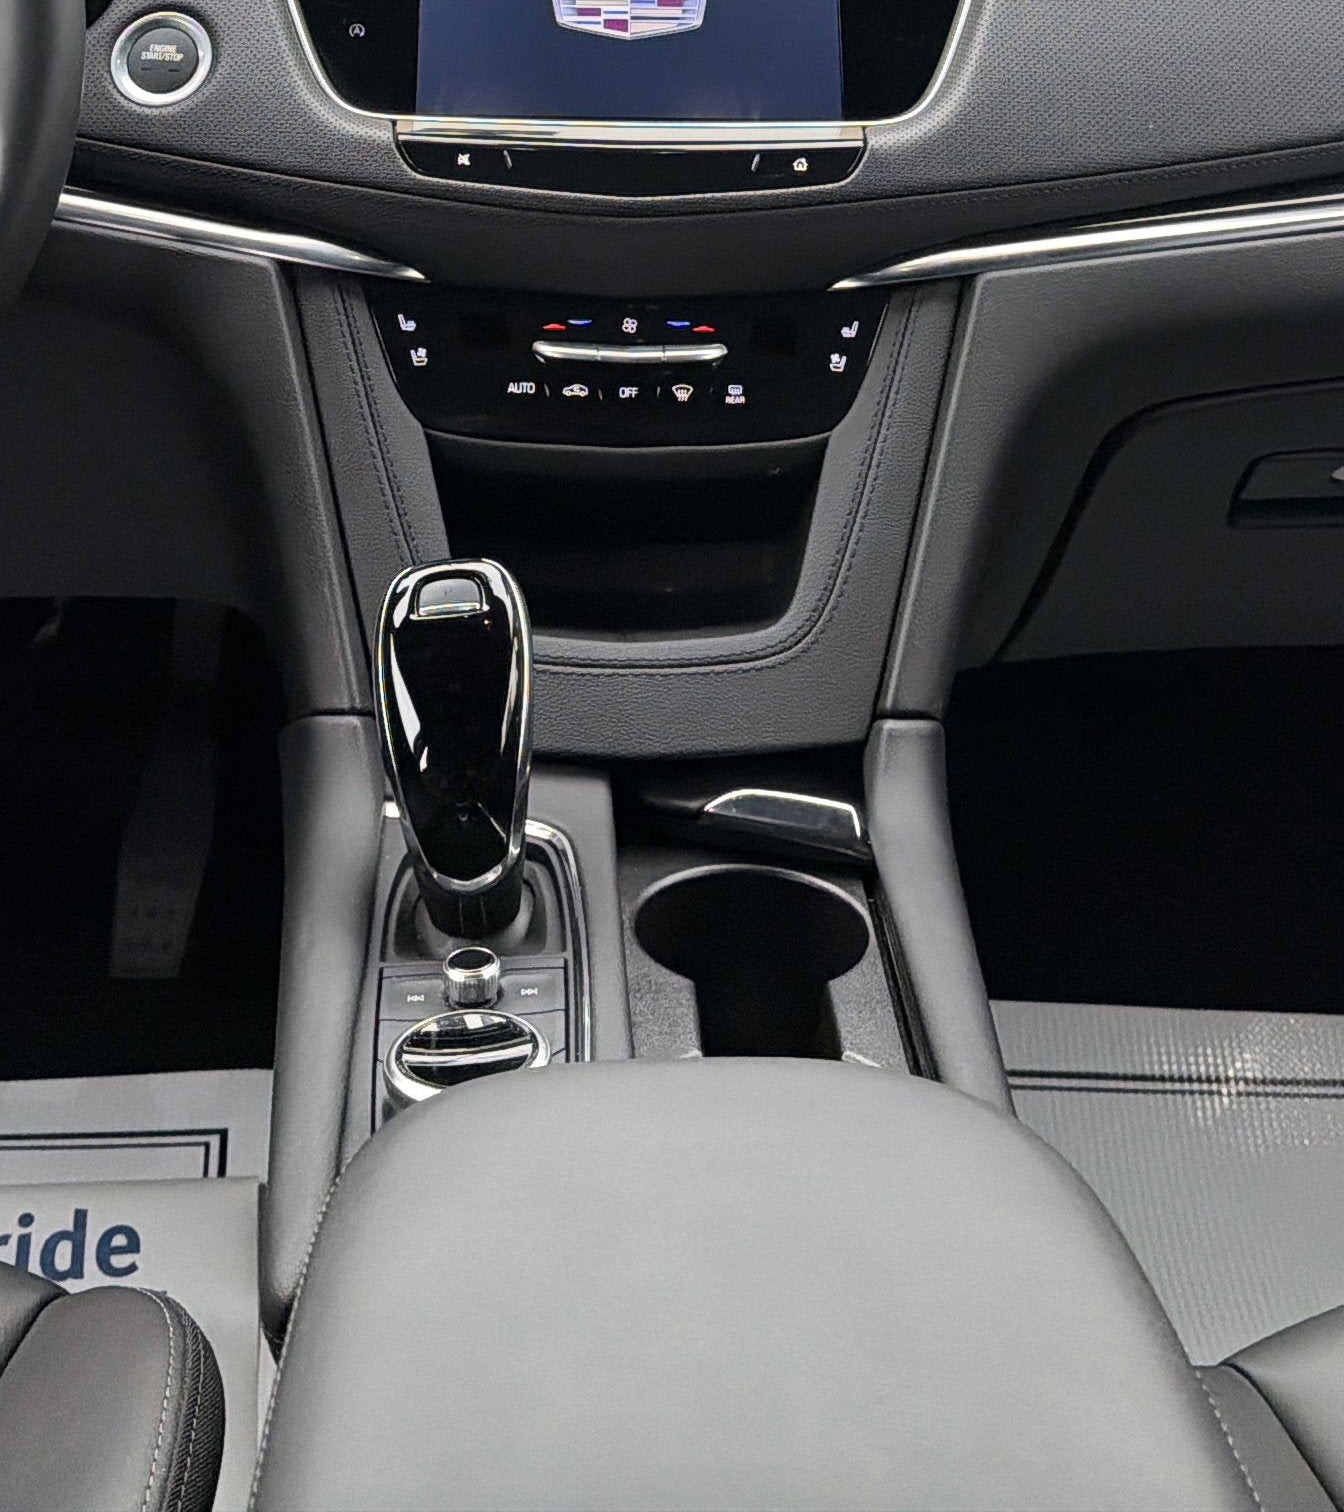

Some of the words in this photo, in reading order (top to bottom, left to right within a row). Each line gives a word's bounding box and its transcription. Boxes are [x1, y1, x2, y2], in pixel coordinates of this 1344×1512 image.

[149, 44, 178, 53] ENGINE
[507, 382, 536, 395] AUTO
[618, 386, 639, 399] OFF
[725, 396, 745, 404] REAR
